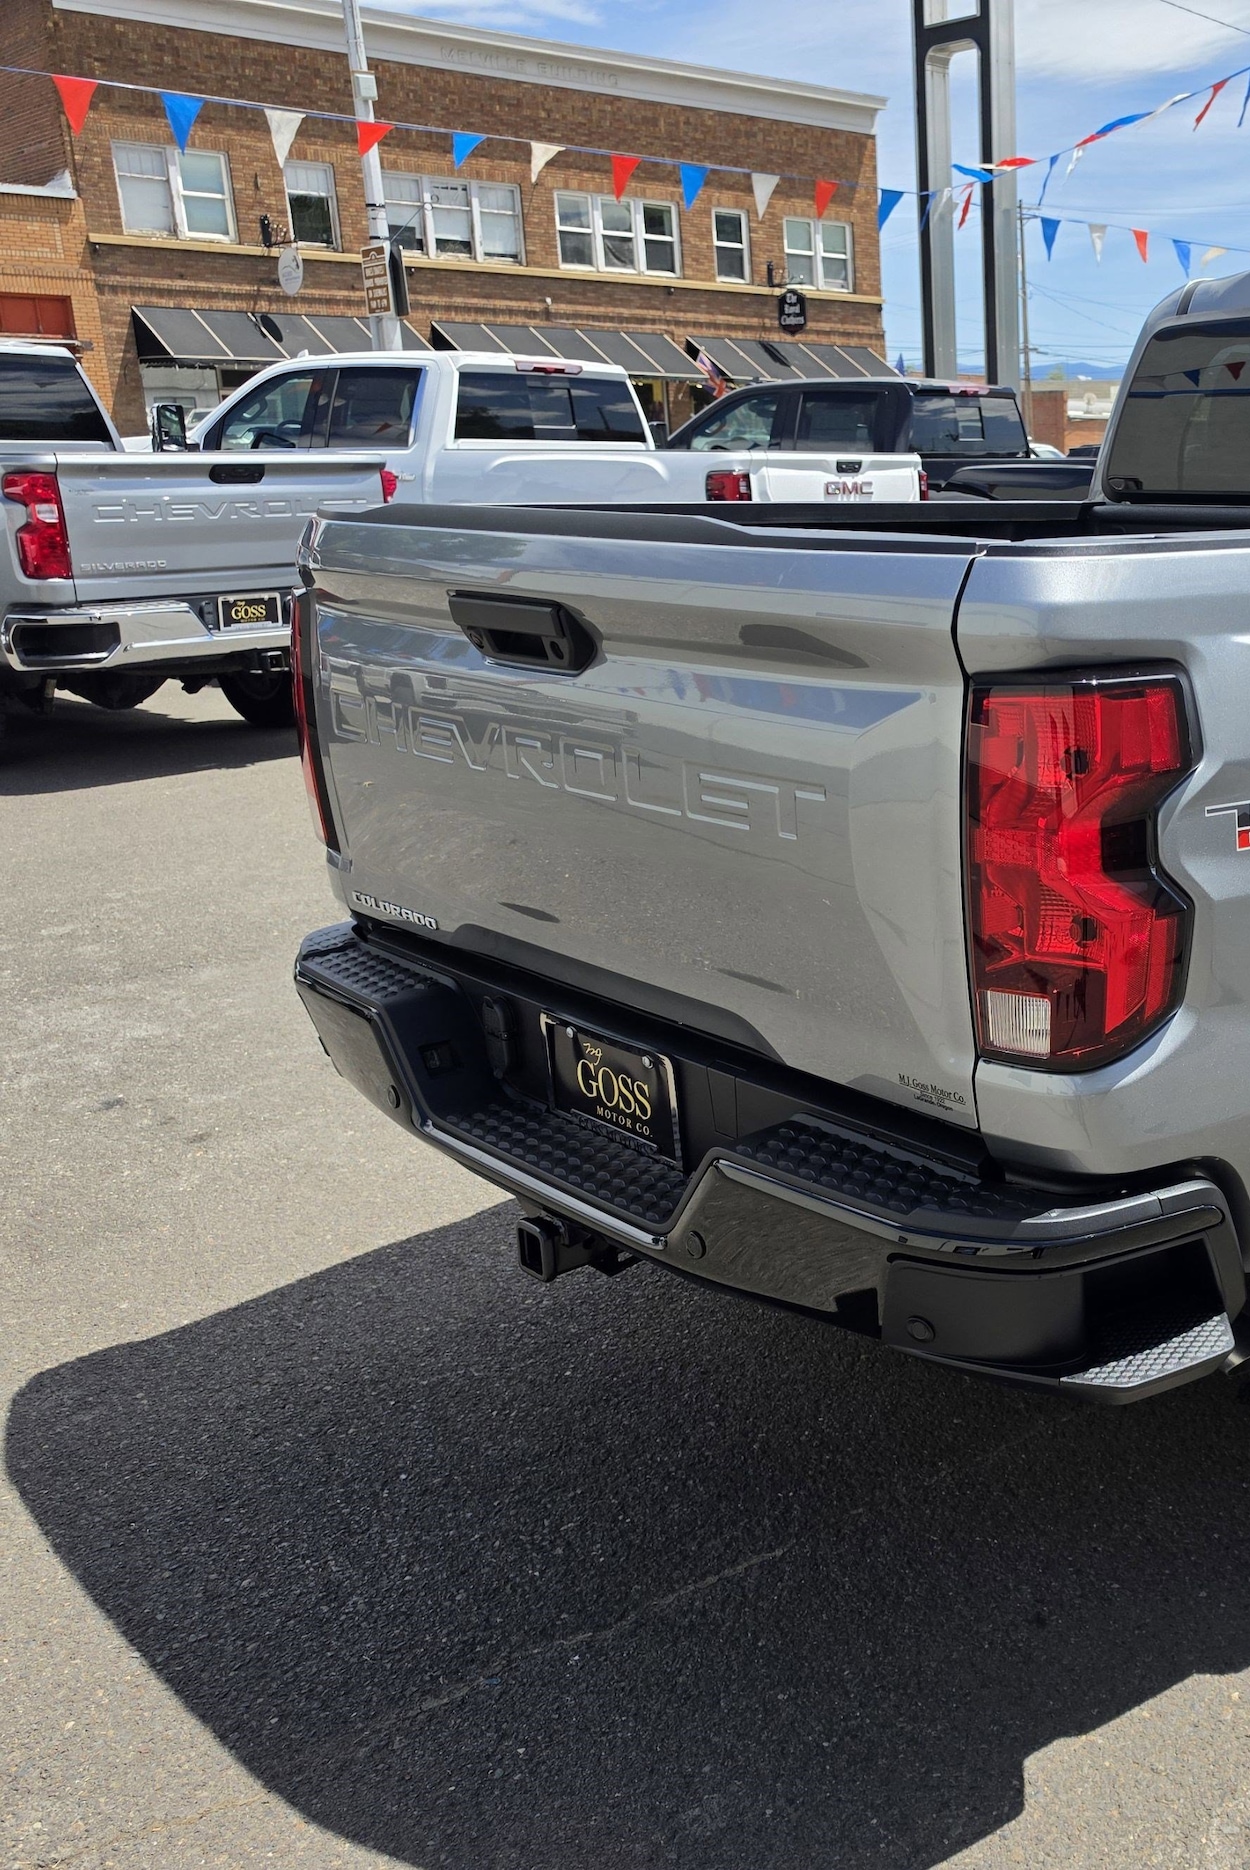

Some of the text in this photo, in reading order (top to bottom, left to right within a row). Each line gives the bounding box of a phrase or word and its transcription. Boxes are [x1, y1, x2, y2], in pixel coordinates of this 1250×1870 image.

[825, 480, 874, 496] GMC
[92, 500, 367, 523] CHEVROL
[80, 559, 168, 572] SILVERADO
[231, 604, 267, 620] GOSS
[329, 686, 827, 841] CHEVROLET
[351, 889, 438, 931] COLORADO
[577, 1059, 652, 1120] GOSS
[912, 1079, 930, 1092] Goss
[930, 1084, 952, 1099] Motor
[953, 1091, 966, 1104] Co.
[596, 1105, 632, 1129] MOTOR
[635, 1121, 653, 1138] CO.
